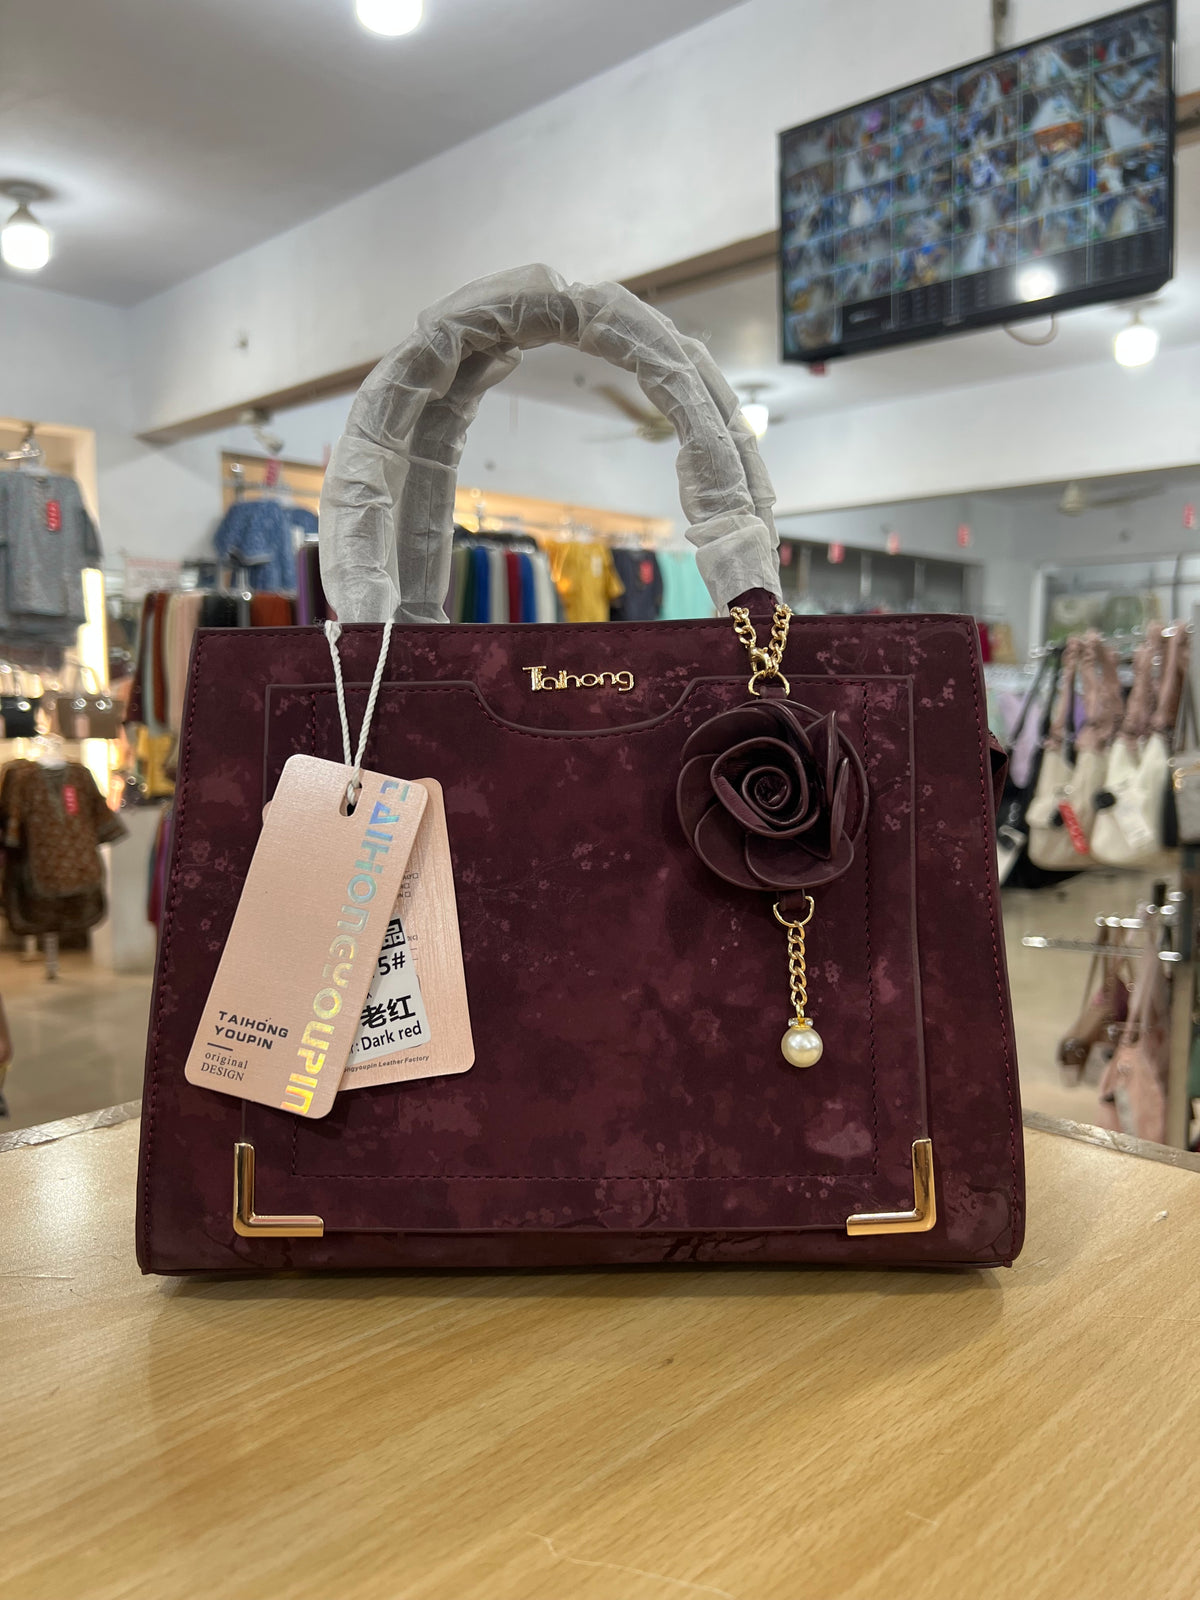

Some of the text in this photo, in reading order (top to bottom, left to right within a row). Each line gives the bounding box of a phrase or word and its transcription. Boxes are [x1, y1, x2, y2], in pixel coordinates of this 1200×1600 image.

[218, 1010, 289, 1038] TAIHONG
[360, 994, 416, 1029] 老红
[214, 1025, 274, 1050] YOUPIN
[360, 1029, 396, 1051] Dark
[398, 1019, 422, 1040] red
[200, 1062, 245, 1082] DESIGN
[204, 1051, 249, 1070] original
[378, 1058, 404, 1068] Leather
[404, 1055, 430, 1064] Factory
